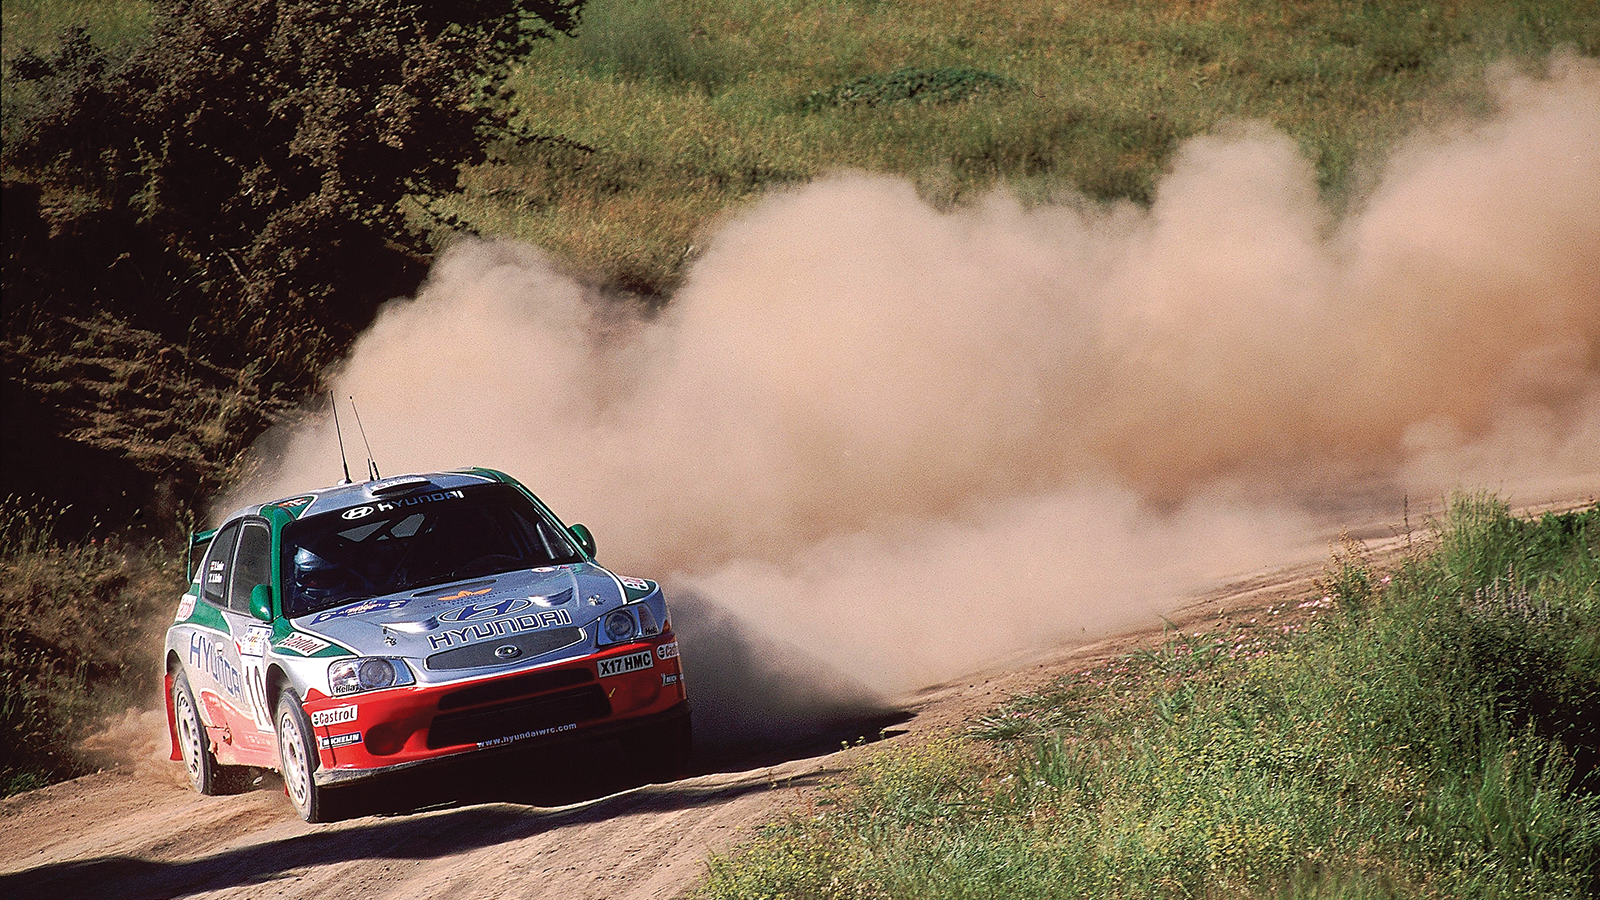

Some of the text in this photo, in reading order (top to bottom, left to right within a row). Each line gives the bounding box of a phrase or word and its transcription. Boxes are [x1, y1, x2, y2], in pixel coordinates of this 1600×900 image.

[377, 490, 465, 512] HYUNDAI
[427, 608, 573, 650] HYUNDAI
[600, 652, 652, 676] X17 HMC
[245, 665, 271, 727] 10
[335, 684, 356, 693] Hella
[319, 707, 354, 724] Castrol
[323, 733, 360, 746] MICHELIN
[476, 722, 577, 748] www.hyundaiwrc.com
